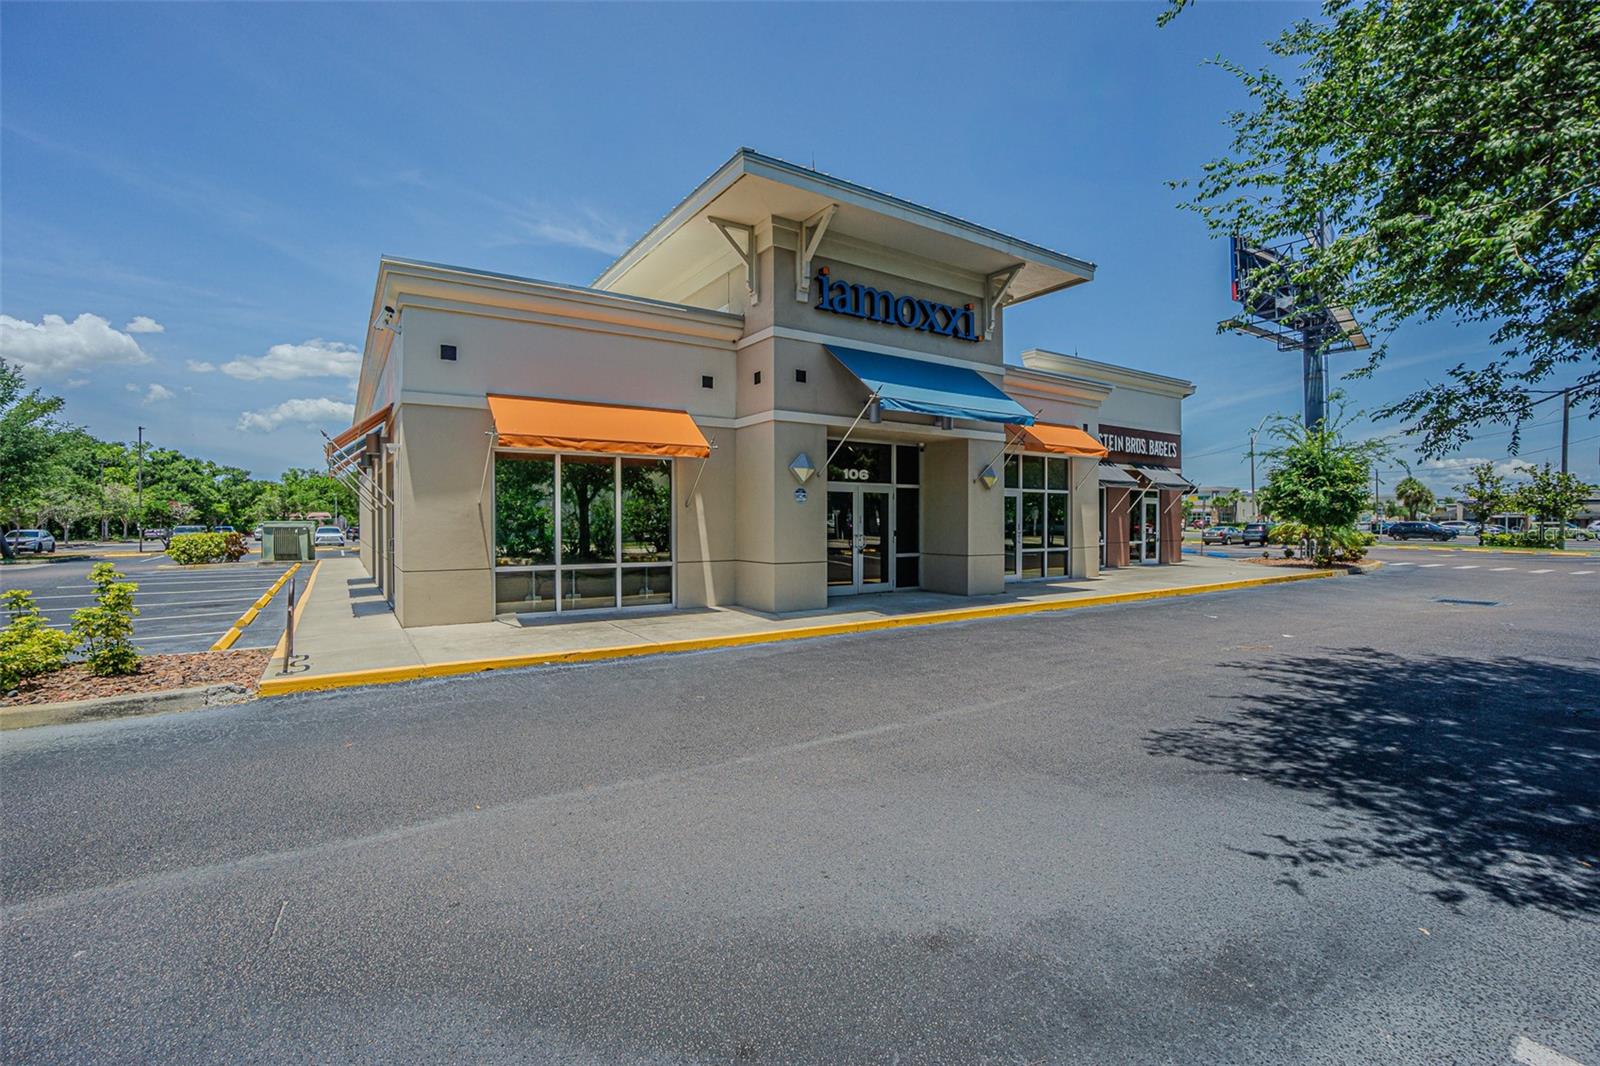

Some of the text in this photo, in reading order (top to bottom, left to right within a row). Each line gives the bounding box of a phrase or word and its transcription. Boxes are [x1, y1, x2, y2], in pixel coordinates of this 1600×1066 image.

[1125, 436, 1147, 454] BROS.
[1149, 439, 1178, 458] BAGELS
[843, 468, 869, 480] 106
